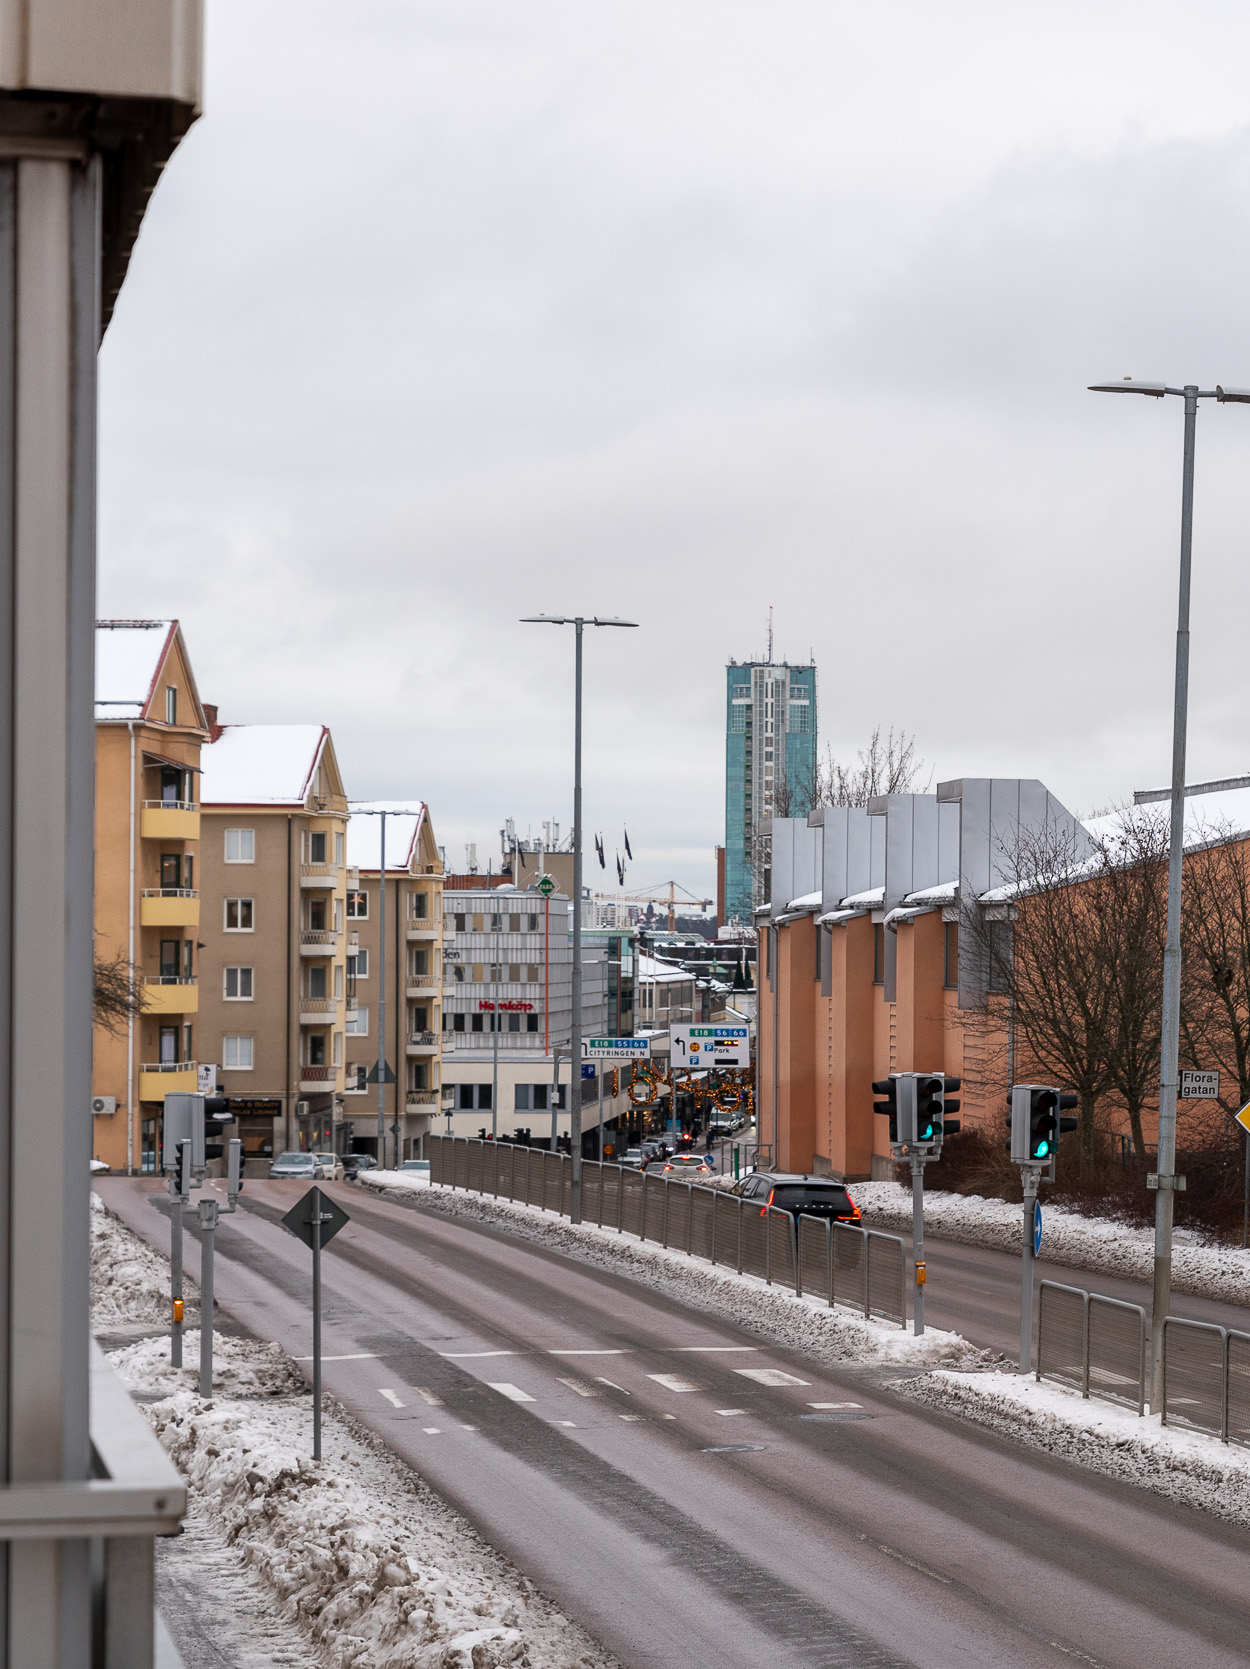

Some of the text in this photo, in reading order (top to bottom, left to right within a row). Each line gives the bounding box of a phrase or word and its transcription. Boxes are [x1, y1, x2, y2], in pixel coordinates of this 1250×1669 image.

[479, 1000, 533, 1011] Hemköp
[1184, 1073, 1217, 1082] Flora-
[1184, 1085, 1215, 1096] gatan
